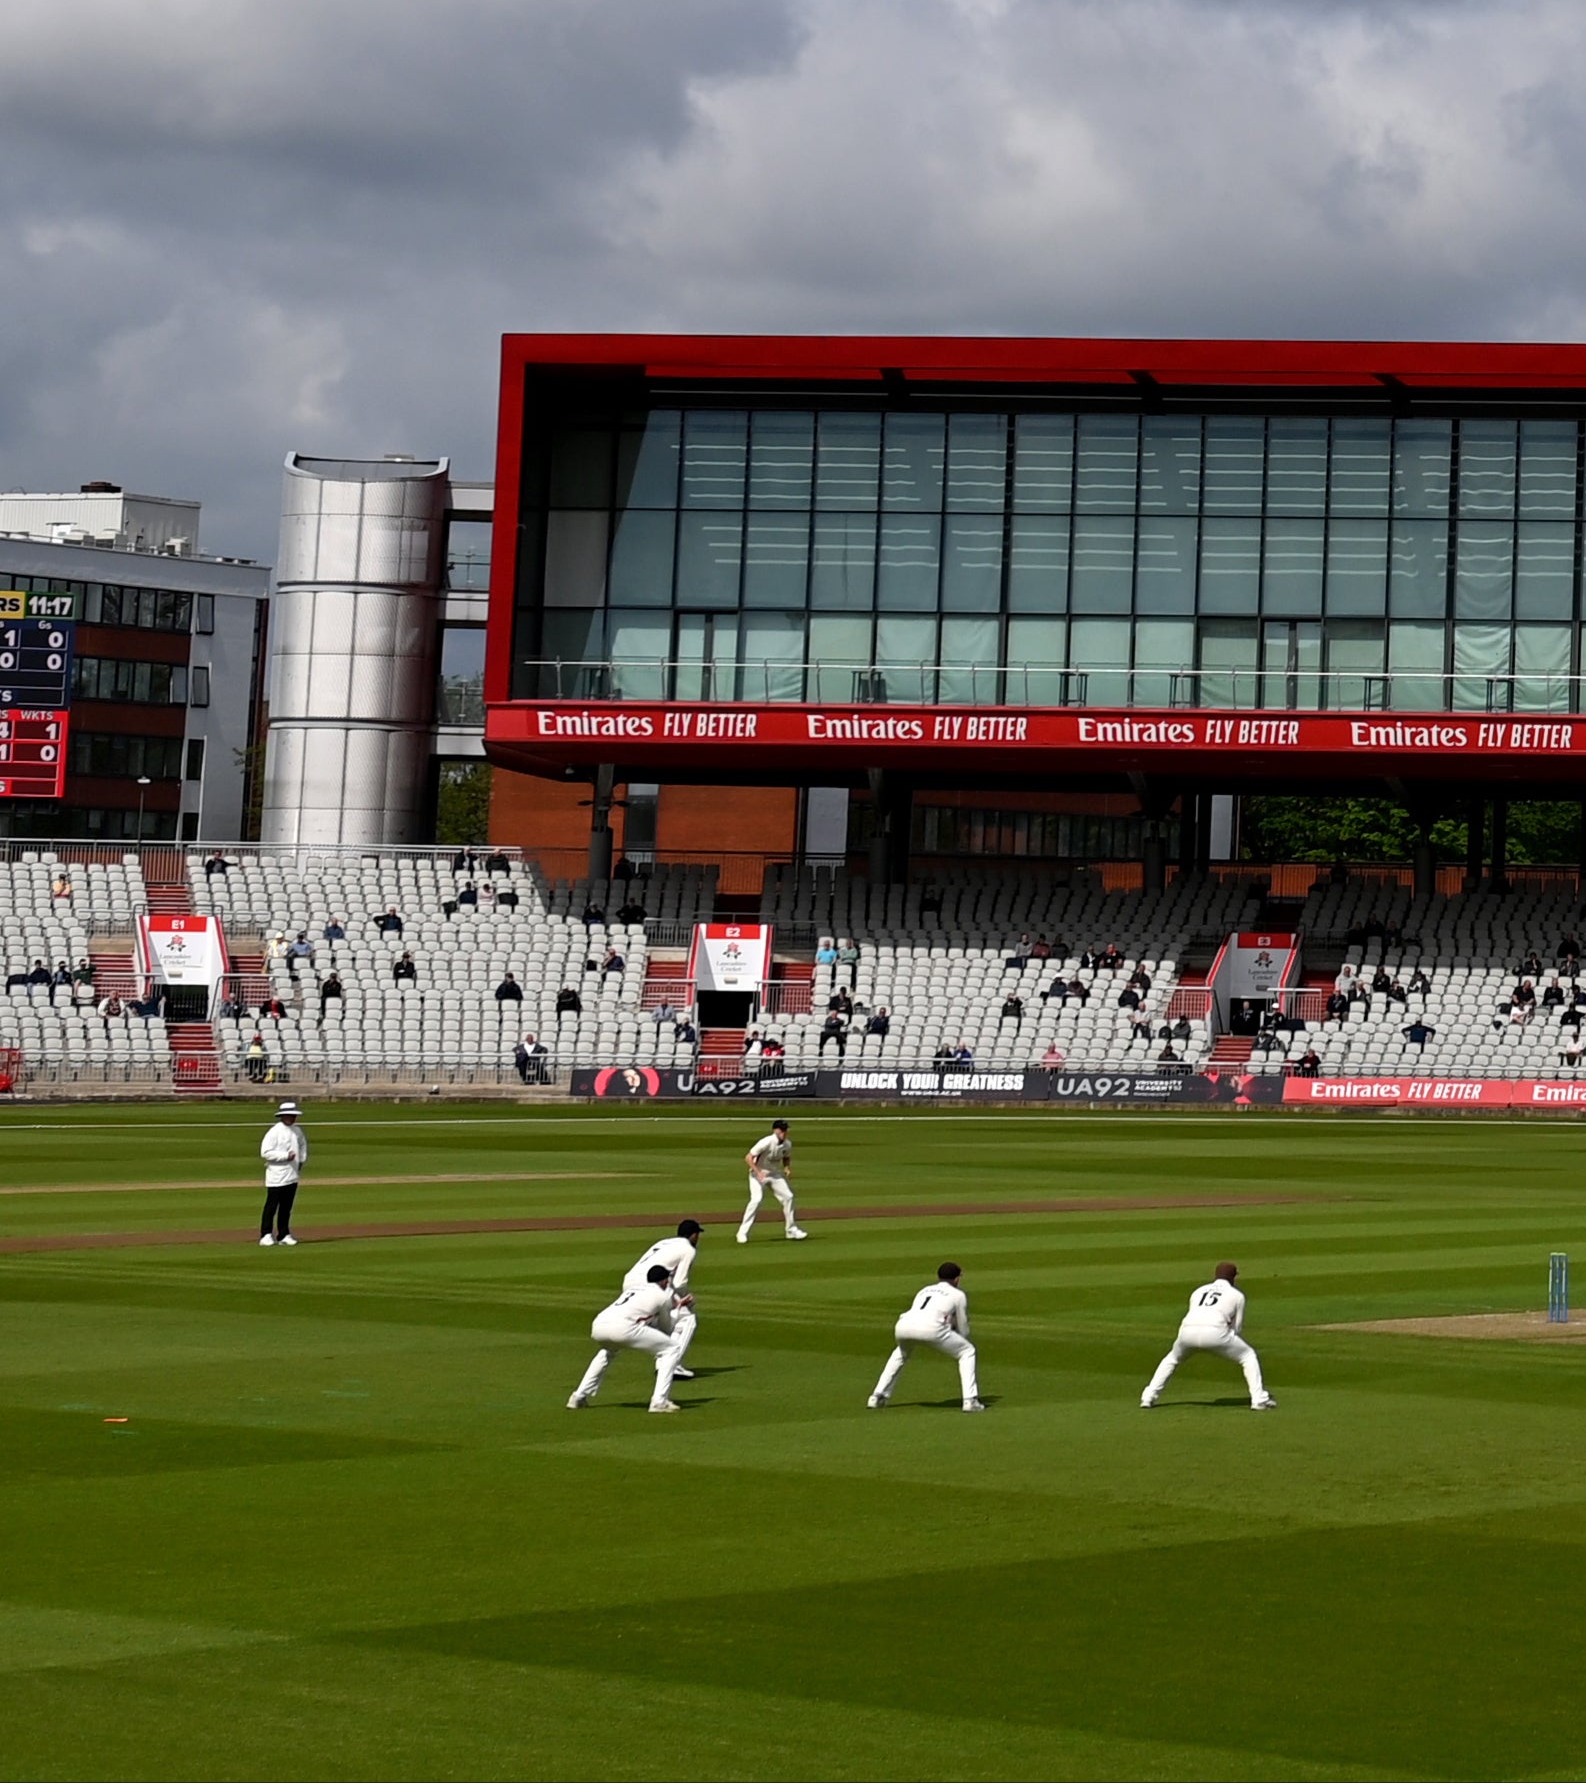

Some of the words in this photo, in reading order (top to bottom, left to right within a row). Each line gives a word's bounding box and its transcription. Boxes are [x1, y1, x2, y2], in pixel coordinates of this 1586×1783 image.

[28, 595, 73, 616] 11:17
[38, 620, 52, 630] 6s
[4, 629, 16, 647] 1
[48, 631, 63, 648] 0
[0, 651, 14, 669] 0
[46, 653, 62, 670] 0
[20, 709, 54, 721] WKTS
[45, 723, 57, 740] 1
[538, 712, 653, 735] Emirates
[663, 713, 692, 737] FLY
[696, 713, 757, 737] BETTER
[807, 715, 923, 739] Emirates
[933, 717, 963, 741] FLY
[966, 717, 1027, 741] BETTER
[1078, 718, 1194, 742] Emirates
[1205, 720, 1234, 744] FLY
[1238, 720, 1299, 744] BETTER
[1351, 722, 1467, 746] Emirates
[1478, 723, 1506, 747] FLY
[1510, 724, 1572, 748] BETTER
[40, 744, 55, 761] 0
[171, 919, 185, 930] E1
[725, 927, 741, 937] E2
[1257, 936, 1271, 946] E3
[840, 1073, 898, 1089] UNLOCK
[943, 1074, 1025, 1090] GREATNESS
[1057, 1078, 1131, 1097] UA92
[1311, 1080, 1401, 1098] Emirates
[1407, 1083, 1432, 1100] FLY
[1434, 1082, 1482, 1100] BETTER
[919, 1295, 933, 1311] 1
[1198, 1291, 1222, 1307] 15
